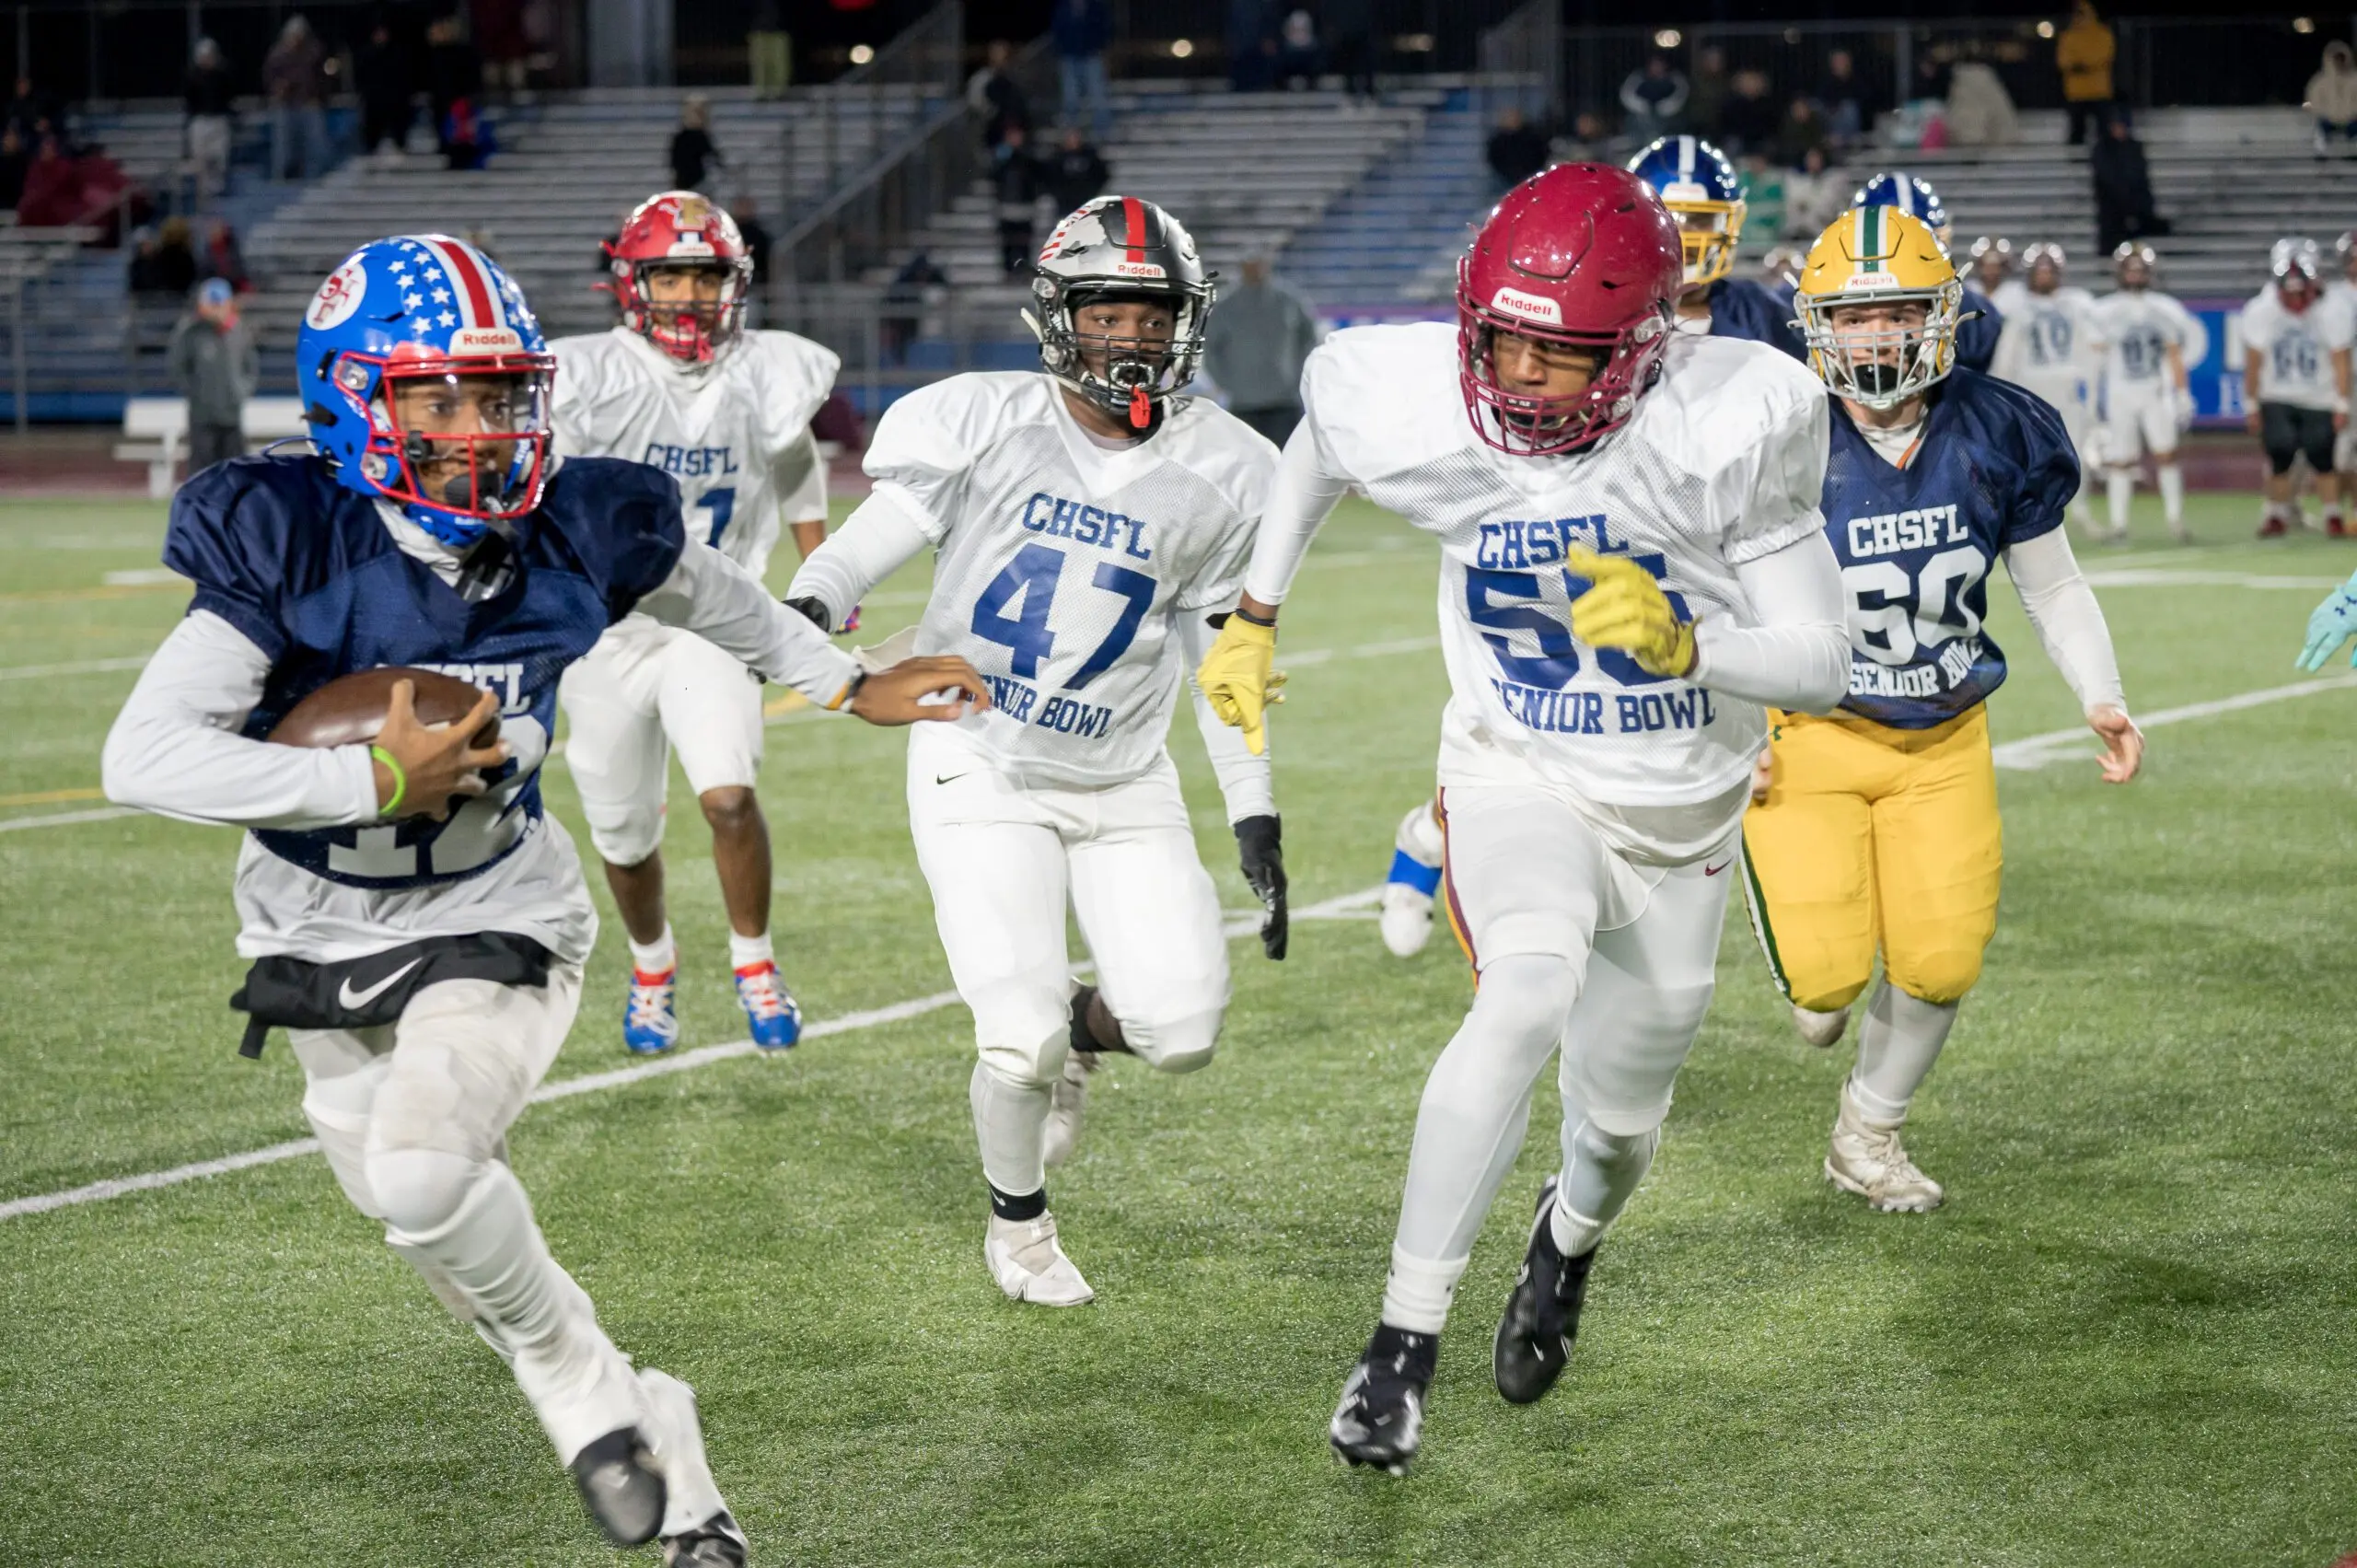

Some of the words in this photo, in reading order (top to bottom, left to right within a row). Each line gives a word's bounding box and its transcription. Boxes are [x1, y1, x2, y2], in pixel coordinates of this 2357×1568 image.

[1118, 264, 1161, 276] Riddell
[1501, 294, 1552, 316] Riddell
[463, 333, 517, 345] Riddell
[644, 442, 740, 477] CHSFL
[1023, 493, 1152, 561] CHSFL
[1477, 514, 1629, 569] CHSFL
[1847, 505, 1968, 558] CHSFL
[971, 542, 1158, 691] 47
[1841, 545, 1986, 665] 60
[1848, 661, 1941, 698] SENIOR
[1036, 696, 1114, 739] BOWL
[1490, 677, 1604, 735] ENIOR
[1615, 688, 1716, 733] BOWL
